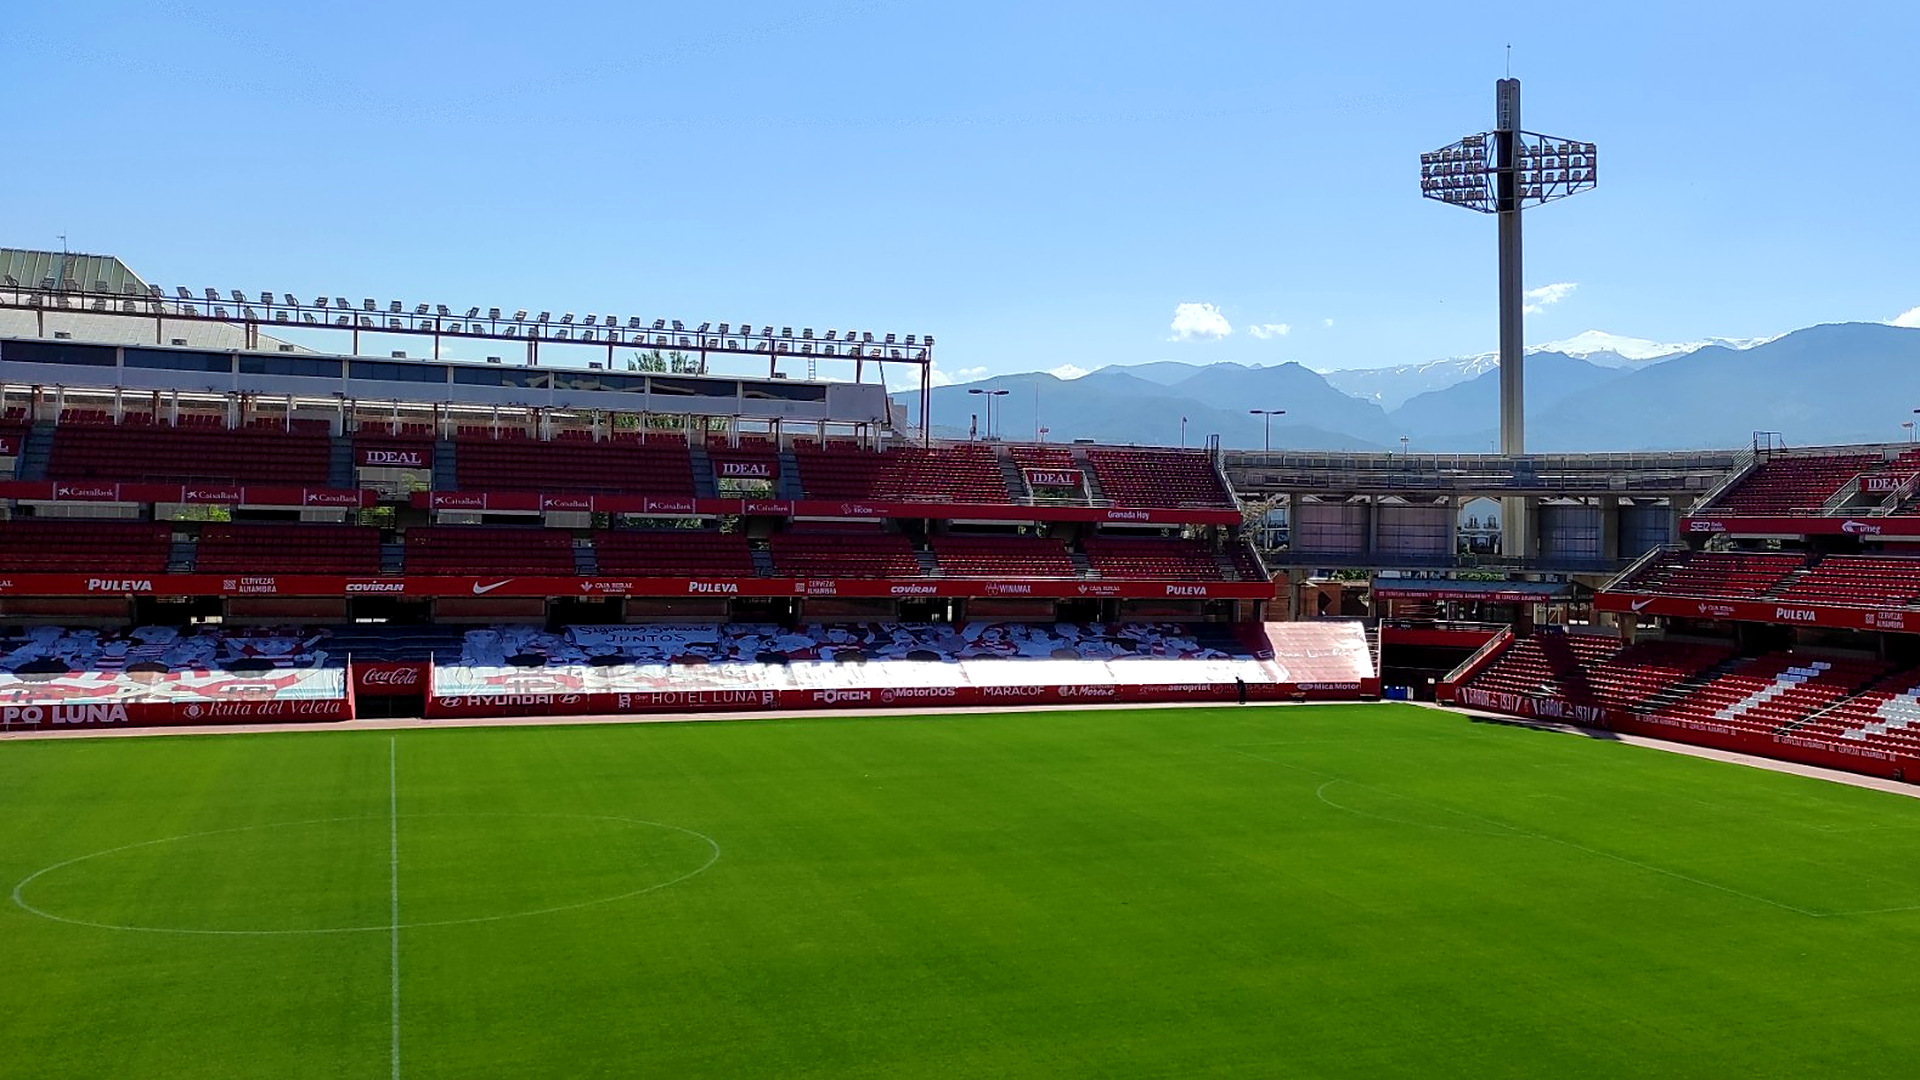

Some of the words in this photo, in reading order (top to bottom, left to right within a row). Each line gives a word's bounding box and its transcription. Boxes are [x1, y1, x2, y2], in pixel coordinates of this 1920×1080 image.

[366, 450, 421, 463] IDEAL
[721, 463, 770, 476] IDEAL
[1032, 473, 1074, 484] IDEAL
[70, 487, 114, 497] CaixaBank
[198, 490, 239, 500] CaixaBank
[444, 495, 483, 506] CaixaBank
[1107, 511, 1135, 519] Granada
[1136, 511, 1150, 521] Hoy
[87, 579, 152, 591] PULEVA
[240, 577, 274, 585] CERVEZAS
[808, 580, 835, 588] CERVEZAS
[238, 585, 276, 594] ALHAMBRA
[688, 581, 737, 593] PULEVA
[1000, 584, 1031, 594] WINAMAX
[1166, 585, 1207, 595] PULEVA
[1776, 608, 1815, 622] PULEVA
[1877, 612, 1902, 621] CERVEZAS
[605, 635, 686, 643] JUNTOS
[651, 692, 706, 704] HOTEL
[713, 690, 757, 703] LUNA
[896, 687, 955, 697] MotorDOS
[983, 686, 1044, 697] MARACOF
[467, 694, 553, 707] HYUNDAI
[207, 701, 251, 716] Ruta
[257, 701, 283, 715] del
[290, 699, 340, 715] Veleta
[52, 704, 129, 724] LUNA
